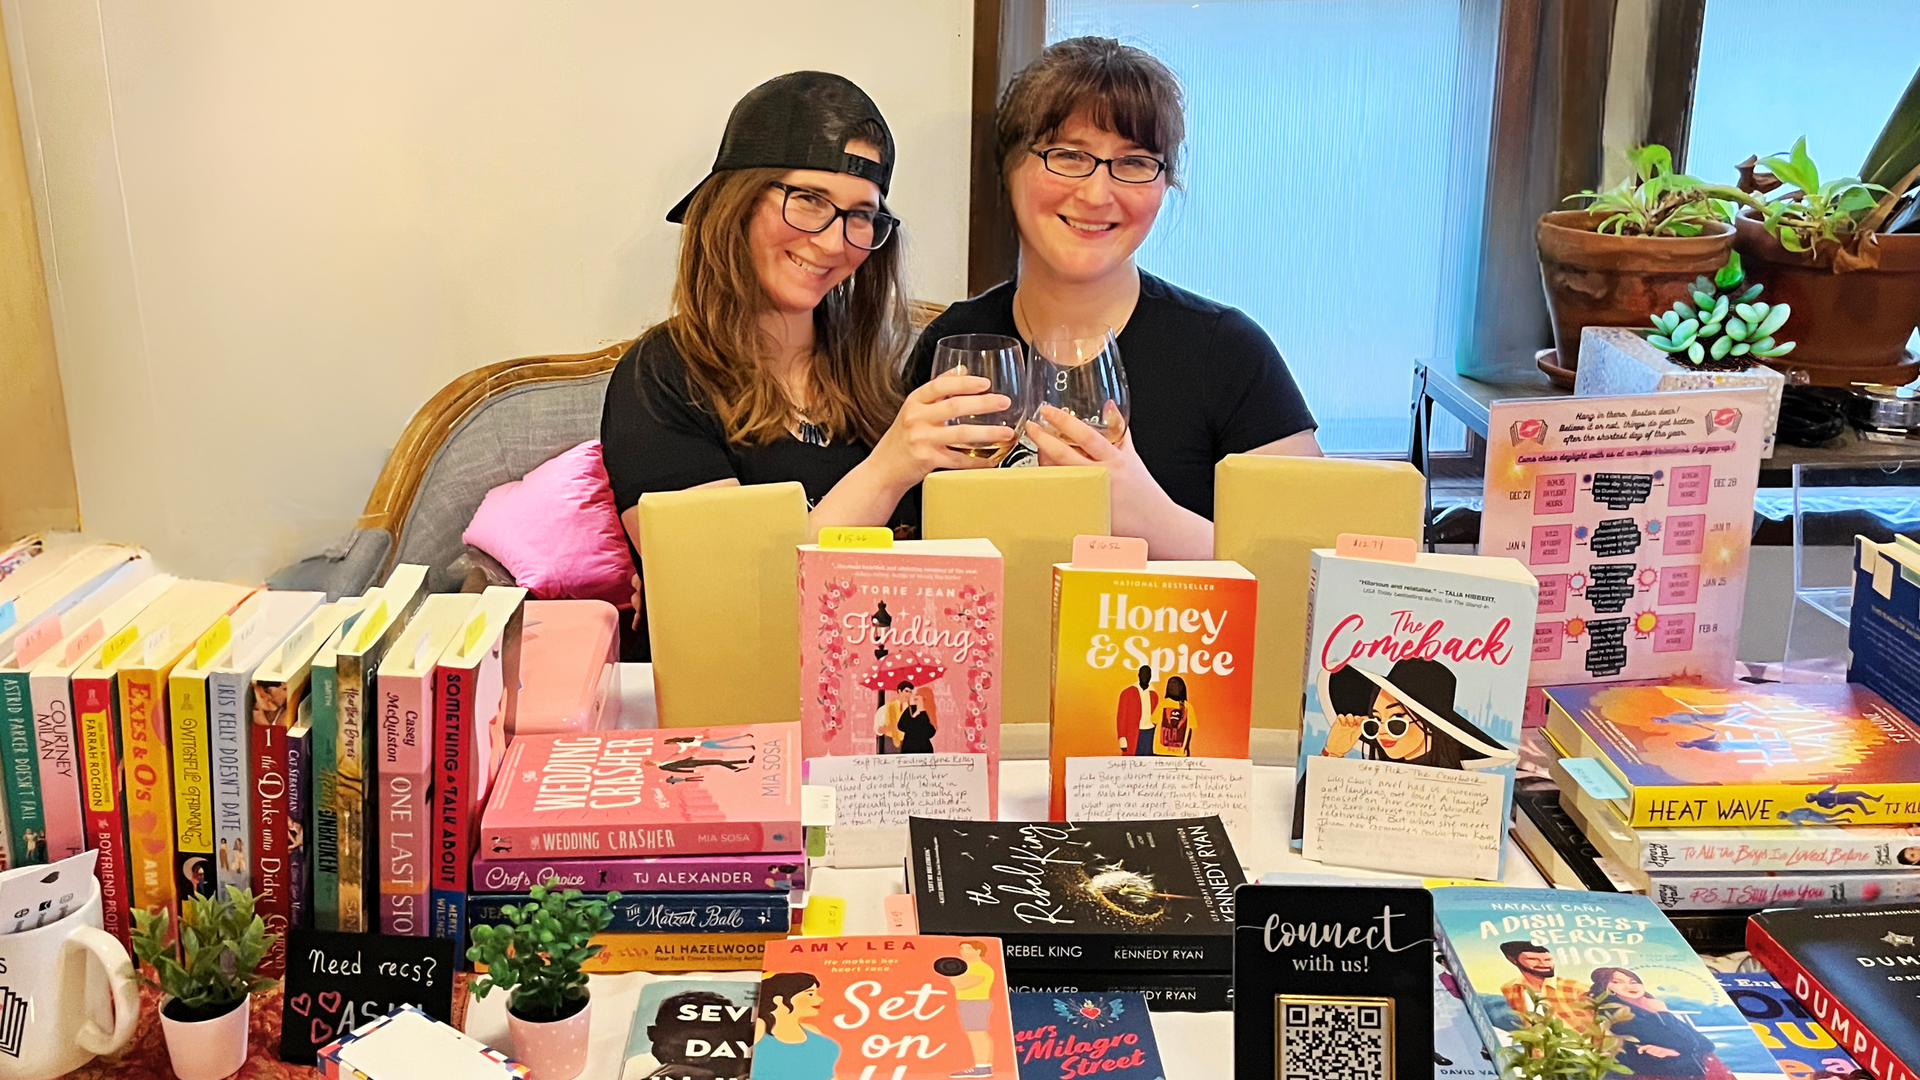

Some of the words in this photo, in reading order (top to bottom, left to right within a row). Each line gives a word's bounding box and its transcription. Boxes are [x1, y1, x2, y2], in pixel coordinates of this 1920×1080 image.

[1559, 423, 1585, 432] Believe
[1623, 420, 1645, 431] things
[1672, 418, 1695, 426] better
[1563, 434, 1582, 445] after
[1583, 433, 1595, 442] the
[1596, 431, 1627, 441] shortest
[1629, 430, 1643, 441] day
[1654, 428, 1665, 437] the
[1559, 451, 1587, 463] daylight
[1589, 450, 1604, 459] with
[1510, 491, 1523, 500] DEC
[1714, 478, 1726, 487] DEC
[1506, 542, 1519, 550] JAN
[860, 585, 908, 596] TORIE
[916, 587, 956, 598] JEAN
[1113, 580, 1159, 589] NATIONAL
[1162, 581, 1215, 591] BESTSELLER
[1445, 590, 1464, 598] TALIA
[1703, 579, 1717, 587] JAN
[1098, 593, 1228, 645] Honey
[1391, 610, 1426, 636] The
[843, 612, 975, 663] Finding
[1321, 614, 1514, 674] Comeback
[1086, 634, 1119, 669] &
[1122, 635, 1235, 683] Spice
[3, 679, 22, 713] ASTRID
[217, 684, 236, 706] IRIS
[324, 679, 333, 706] SMITH
[127, 679, 151, 748] EXES
[218, 712, 238, 743] KELLY
[386, 691, 401, 764] McQuiston
[443, 673, 461, 772] SOMETHING
[1861, 711, 1899, 737] KLUNE
[9, 718, 29, 753] PARKER
[37, 713, 56, 760] MILAN
[50, 699, 72, 778] COURTNEY
[86, 719, 99, 760] FARRAH
[403, 710, 419, 748] Casey
[1674, 698, 1800, 767] HEAT
[133, 746, 147, 759] &
[180, 717, 202, 782] WITCHFUL
[261, 755, 274, 771] the
[288, 749, 300, 767] CAT
[762, 738, 782, 772] SOSA
[90, 762, 103, 807] ROCHON
[218, 747, 240, 797] DOESN'T
[533, 737, 602, 812] WEDDING
[589, 737, 654, 810] CRASHER
[762, 774, 782, 797] MIA
[257, 771, 285, 826] Duke
[288, 769, 299, 812] SEBASTIAN
[390, 776, 412, 823] ONE
[442, 785, 458, 825] TALK
[21, 801, 37, 820] FAIL
[222, 802, 241, 832] DATE
[1648, 799, 1708, 822] HEAT
[1717, 799, 1774, 821] WAVE
[1884, 802, 1901, 815] TJ
[261, 827, 274, 851] who
[318, 809, 338, 874] UNBROKEN
[542, 832, 600, 851] WEDDING
[608, 828, 675, 850] CRASHER
[698, 834, 718, 843] MIA
[720, 833, 751, 842] SOSA
[1008, 820, 1085, 865] King
[1176, 828, 1190, 849] AUTHOR
[1187, 825, 1218, 857] RYAN
[1658, 844, 1676, 862] Han
[99, 832, 117, 901] BOYFRIEND
[390, 832, 414, 887] LAST
[441, 829, 456, 884] ABOUT
[1185, 851, 1206, 887] BESTSELLING
[1683, 846, 1696, 861] To
[1699, 845, 1714, 860] All
[1733, 844, 1767, 867] Boys
[1785, 845, 1828, 867] Loved
[1829, 847, 1870, 867] Before
[144, 859, 161, 898] AMY
[260, 857, 281, 904] Didn't
[485, 866, 531, 891] Chef's
[633, 872, 650, 884] TJ
[657, 872, 753, 884] ALEXANDER
[992, 863, 1076, 924] Rebel
[1202, 861, 1235, 923] KENNEDY
[966, 882, 1001, 906] the
[1201, 887, 1214, 908] TODAY
[1491, 903, 1556, 912] NATALIE
[1561, 903, 1607, 913] CAÑA
[1726, 886, 1739, 903] I
[1740, 883, 1768, 906] Still
[1770, 883, 1795, 906] Love
[1795, 882, 1825, 906] You
[392, 894, 415, 938] STO
[448, 903, 459, 935] MERYL
[637, 904, 698, 928] Matzah
[699, 905, 744, 928] Ball
[1209, 909, 1220, 922] USA
[1237, 905, 1435, 953] Connect
[1480, 920, 1500, 941] A
[1574, 914, 1652, 932] BEST
[654, 944, 675, 954] ALI
[680, 944, 766, 954] HAZELWOOD
[790, 941, 849, 954] AMY
[866, 941, 917, 951] LEA
[1006, 945, 1045, 957] REBEL
[1048, 946, 1083, 958] KING
[1114, 950, 1169, 960] KENNEDY
[1172, 950, 1204, 960] RYAN
[1528, 928, 1645, 947] SERVED
[308, 949, 362, 976] Need
[378, 956, 438, 987] recs?
[824, 958, 840, 966] He
[842, 958, 878, 966] makes
[880, 957, 899, 965] her
[1292, 955, 1335, 972] with
[1341, 955, 1370, 973] us!
[1556, 946, 1637, 966] HOT
[1856, 955, 1920, 968] DUM
[833, 980, 948, 1030] Set
[1165, 991, 1197, 1001] RYAN
[861, 1034, 948, 1060] on
[1023, 1032, 1139, 1065] Milagro
[1059, 1048, 1146, 1080] Street
